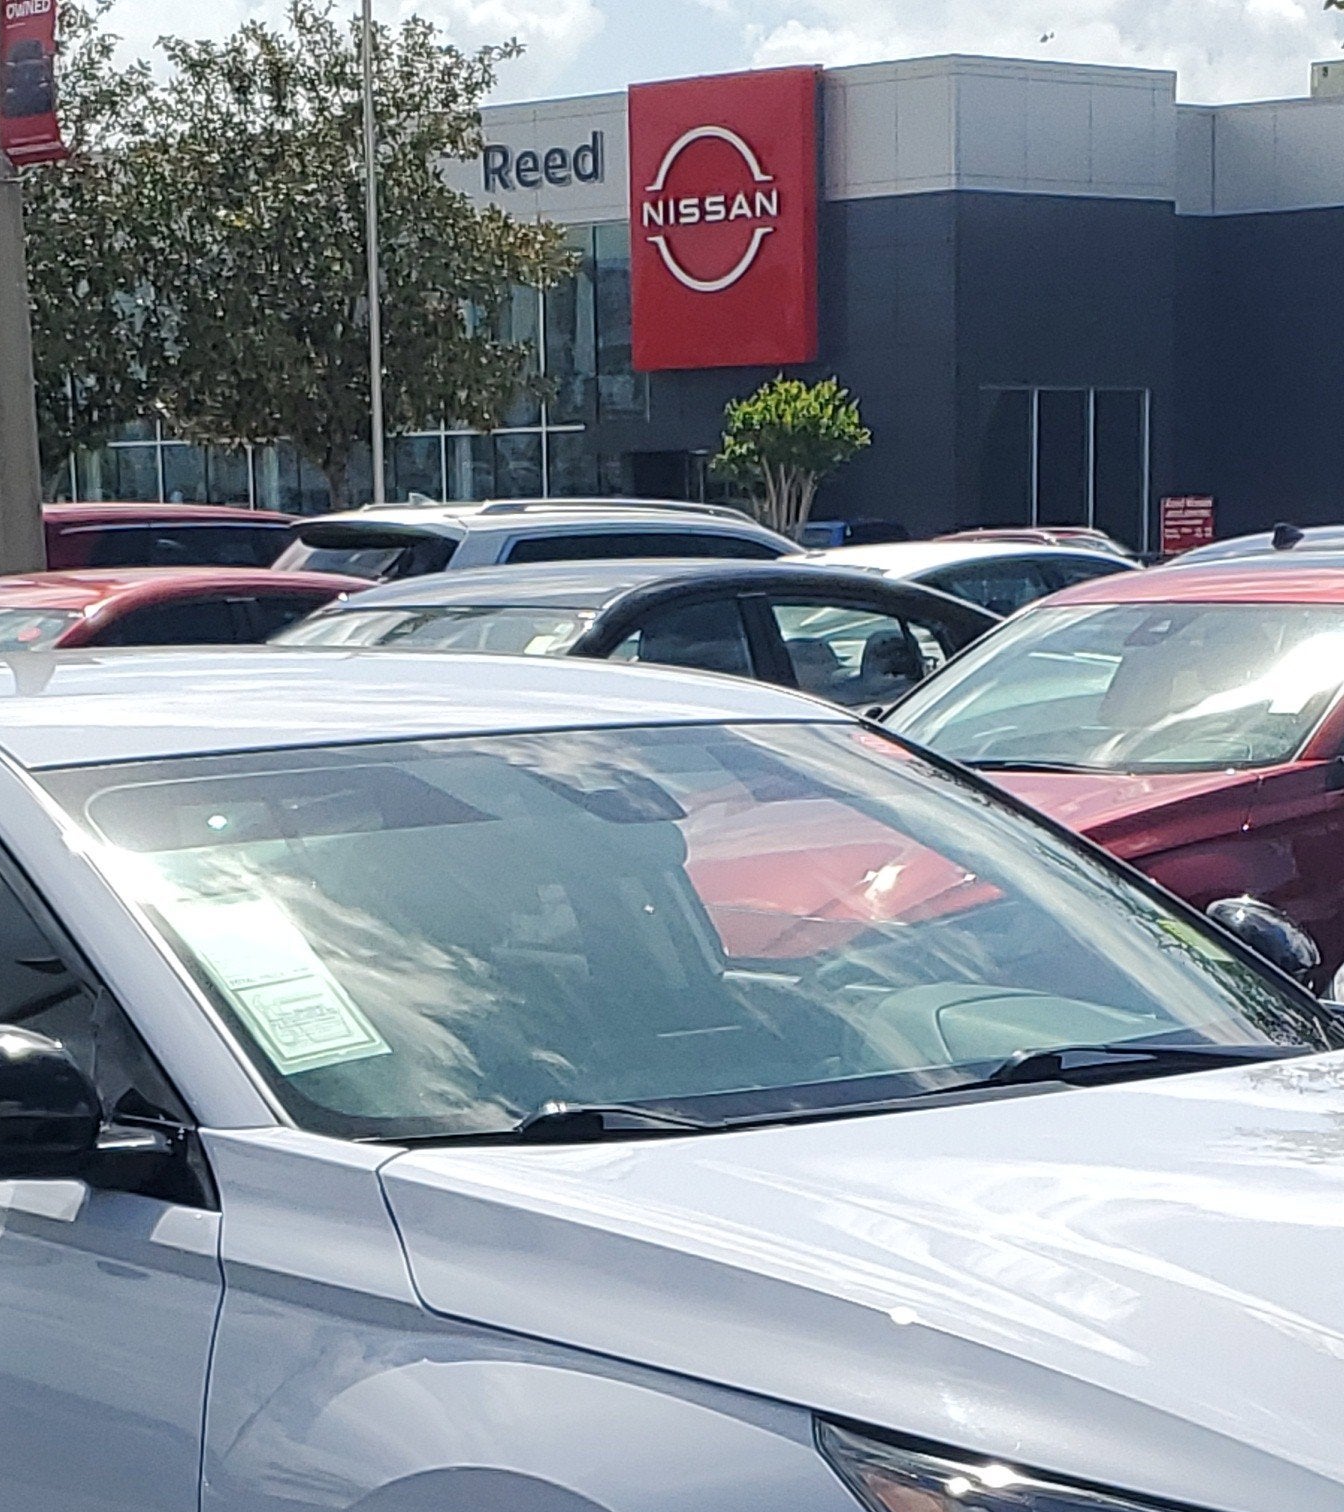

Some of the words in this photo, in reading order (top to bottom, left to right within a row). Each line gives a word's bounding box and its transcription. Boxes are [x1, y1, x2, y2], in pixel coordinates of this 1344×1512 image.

[6, 0, 51, 20] OWNED
[483, 130, 604, 193] Reed
[642, 187, 779, 228] NISSAN
